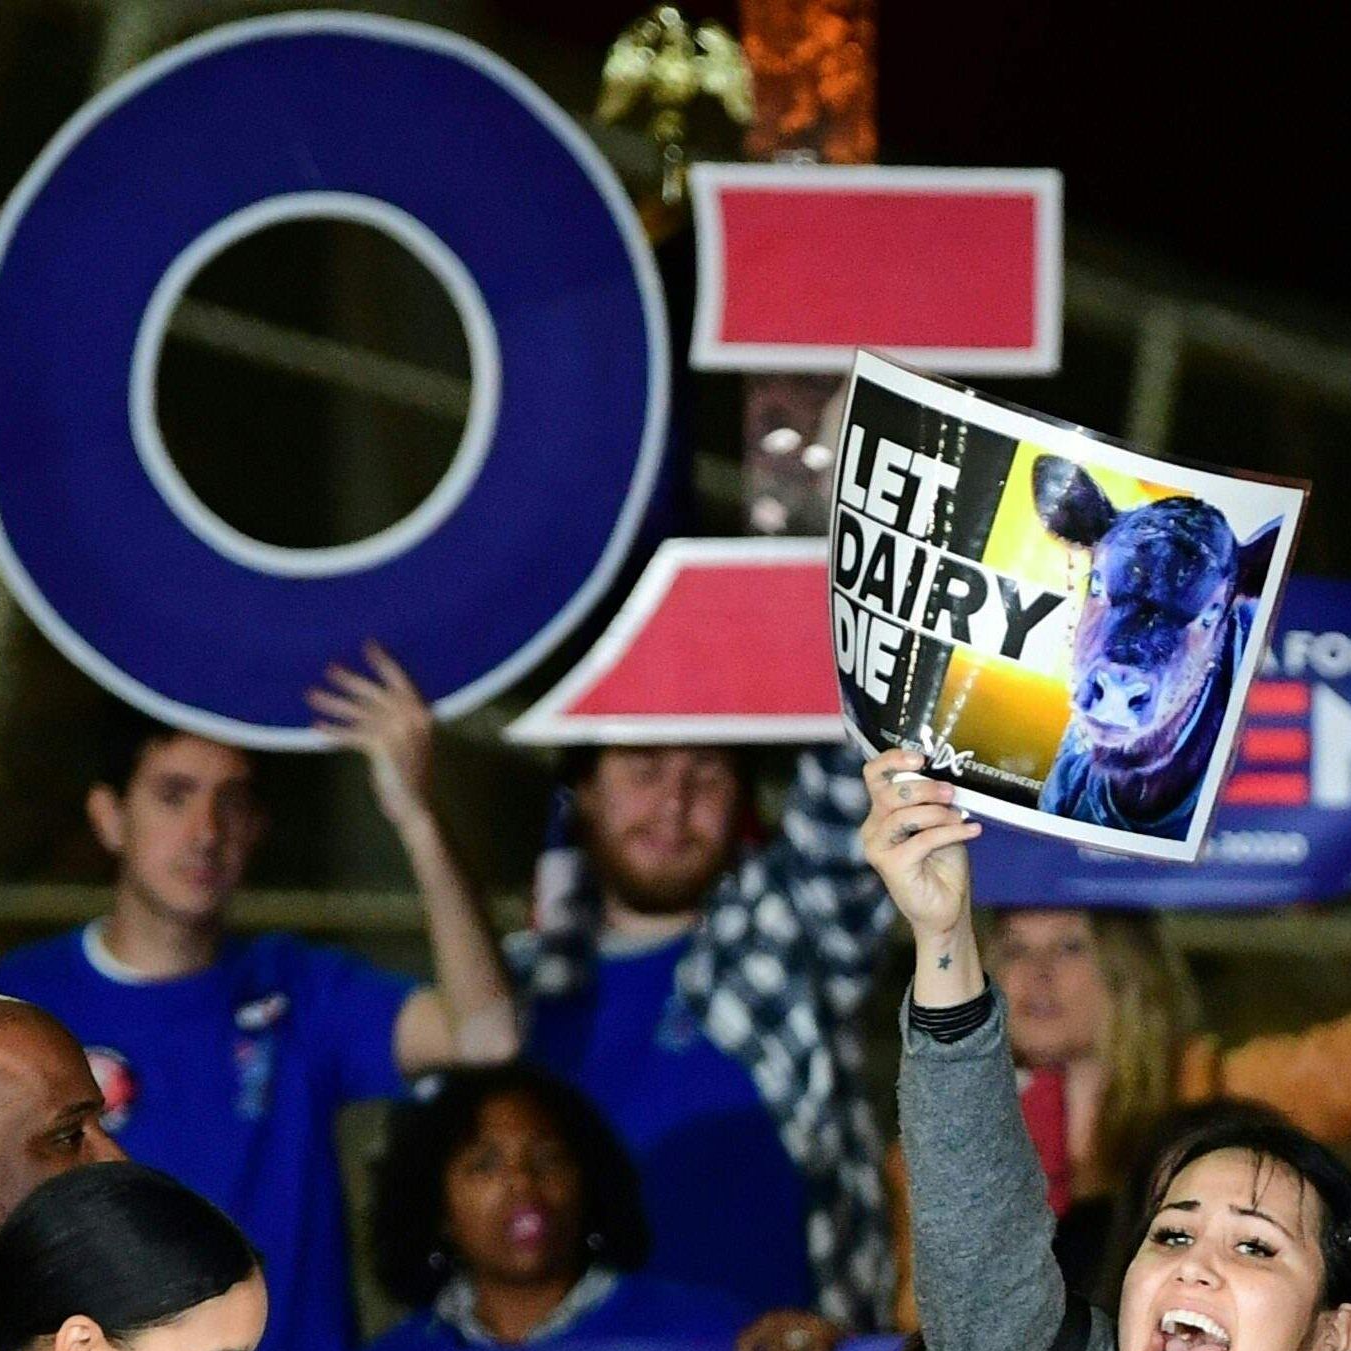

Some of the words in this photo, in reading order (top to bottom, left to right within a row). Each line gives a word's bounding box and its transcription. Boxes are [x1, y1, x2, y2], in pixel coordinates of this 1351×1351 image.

[839, 424, 961, 538] LET
[834, 510, 1067, 661] DAIRY
[833, 591, 905, 705] DIE
[964, 760, 1044, 791] EVERYWHERE
